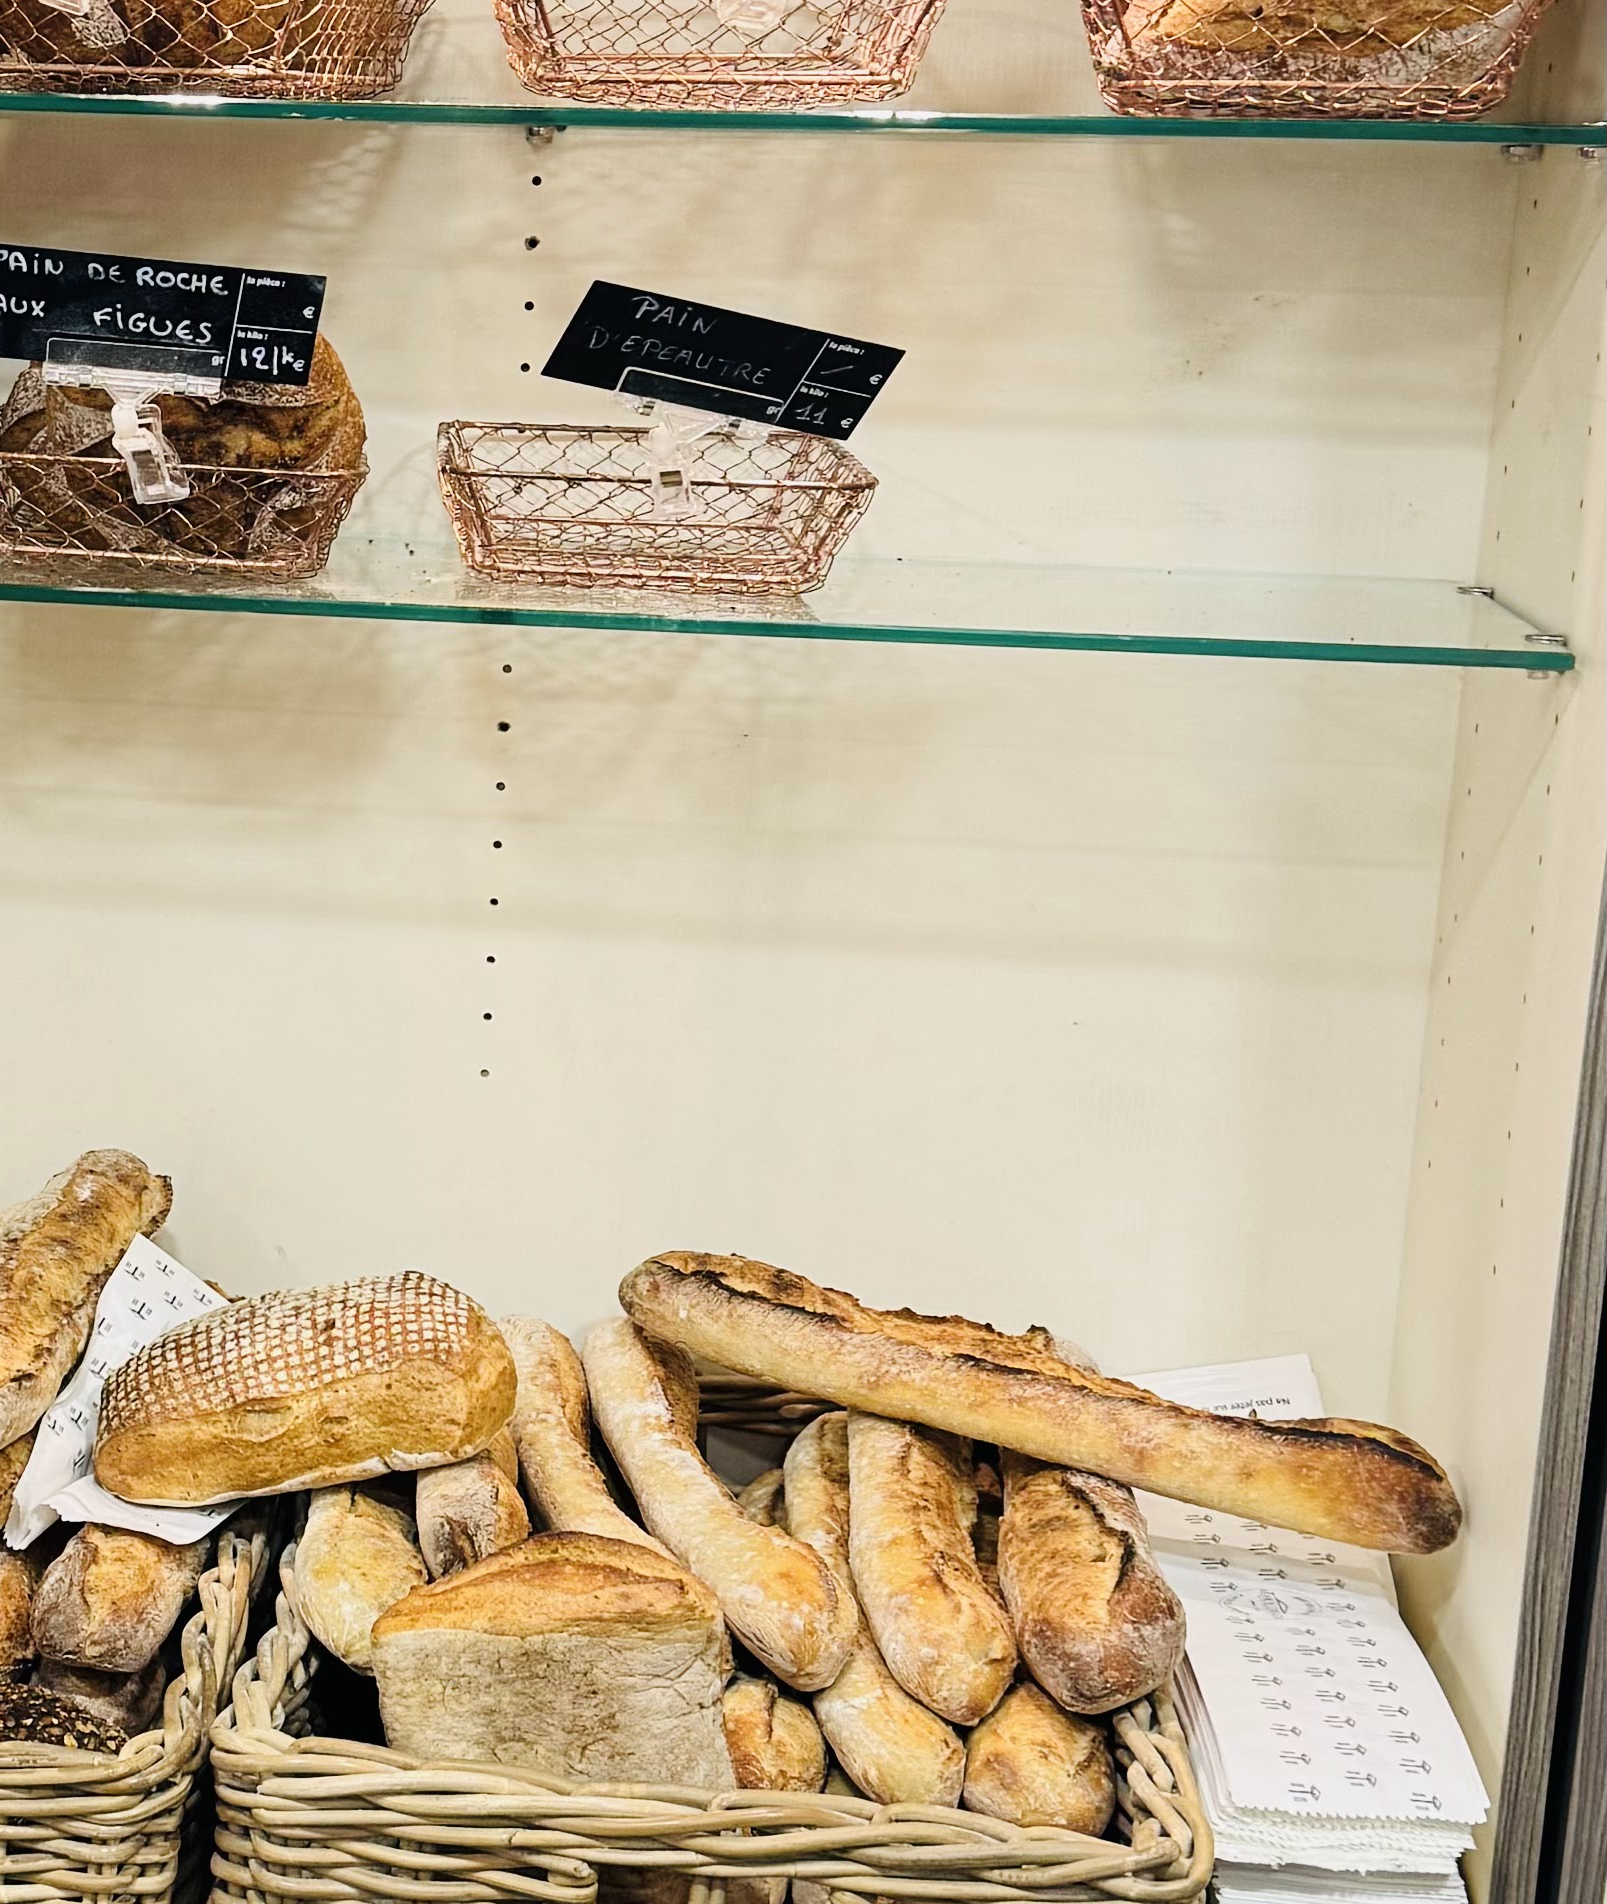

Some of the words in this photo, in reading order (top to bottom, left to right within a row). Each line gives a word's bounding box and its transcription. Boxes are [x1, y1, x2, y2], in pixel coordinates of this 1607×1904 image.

[87, 263, 125, 284] DE
[135, 266, 229, 296] ROCHE
[93, 303, 212, 344] FIGUES
[630, 295, 719, 335] PAIN
[588, 324, 772, 386] D'EPEAUTRE
[794, 402, 828, 425] 11
